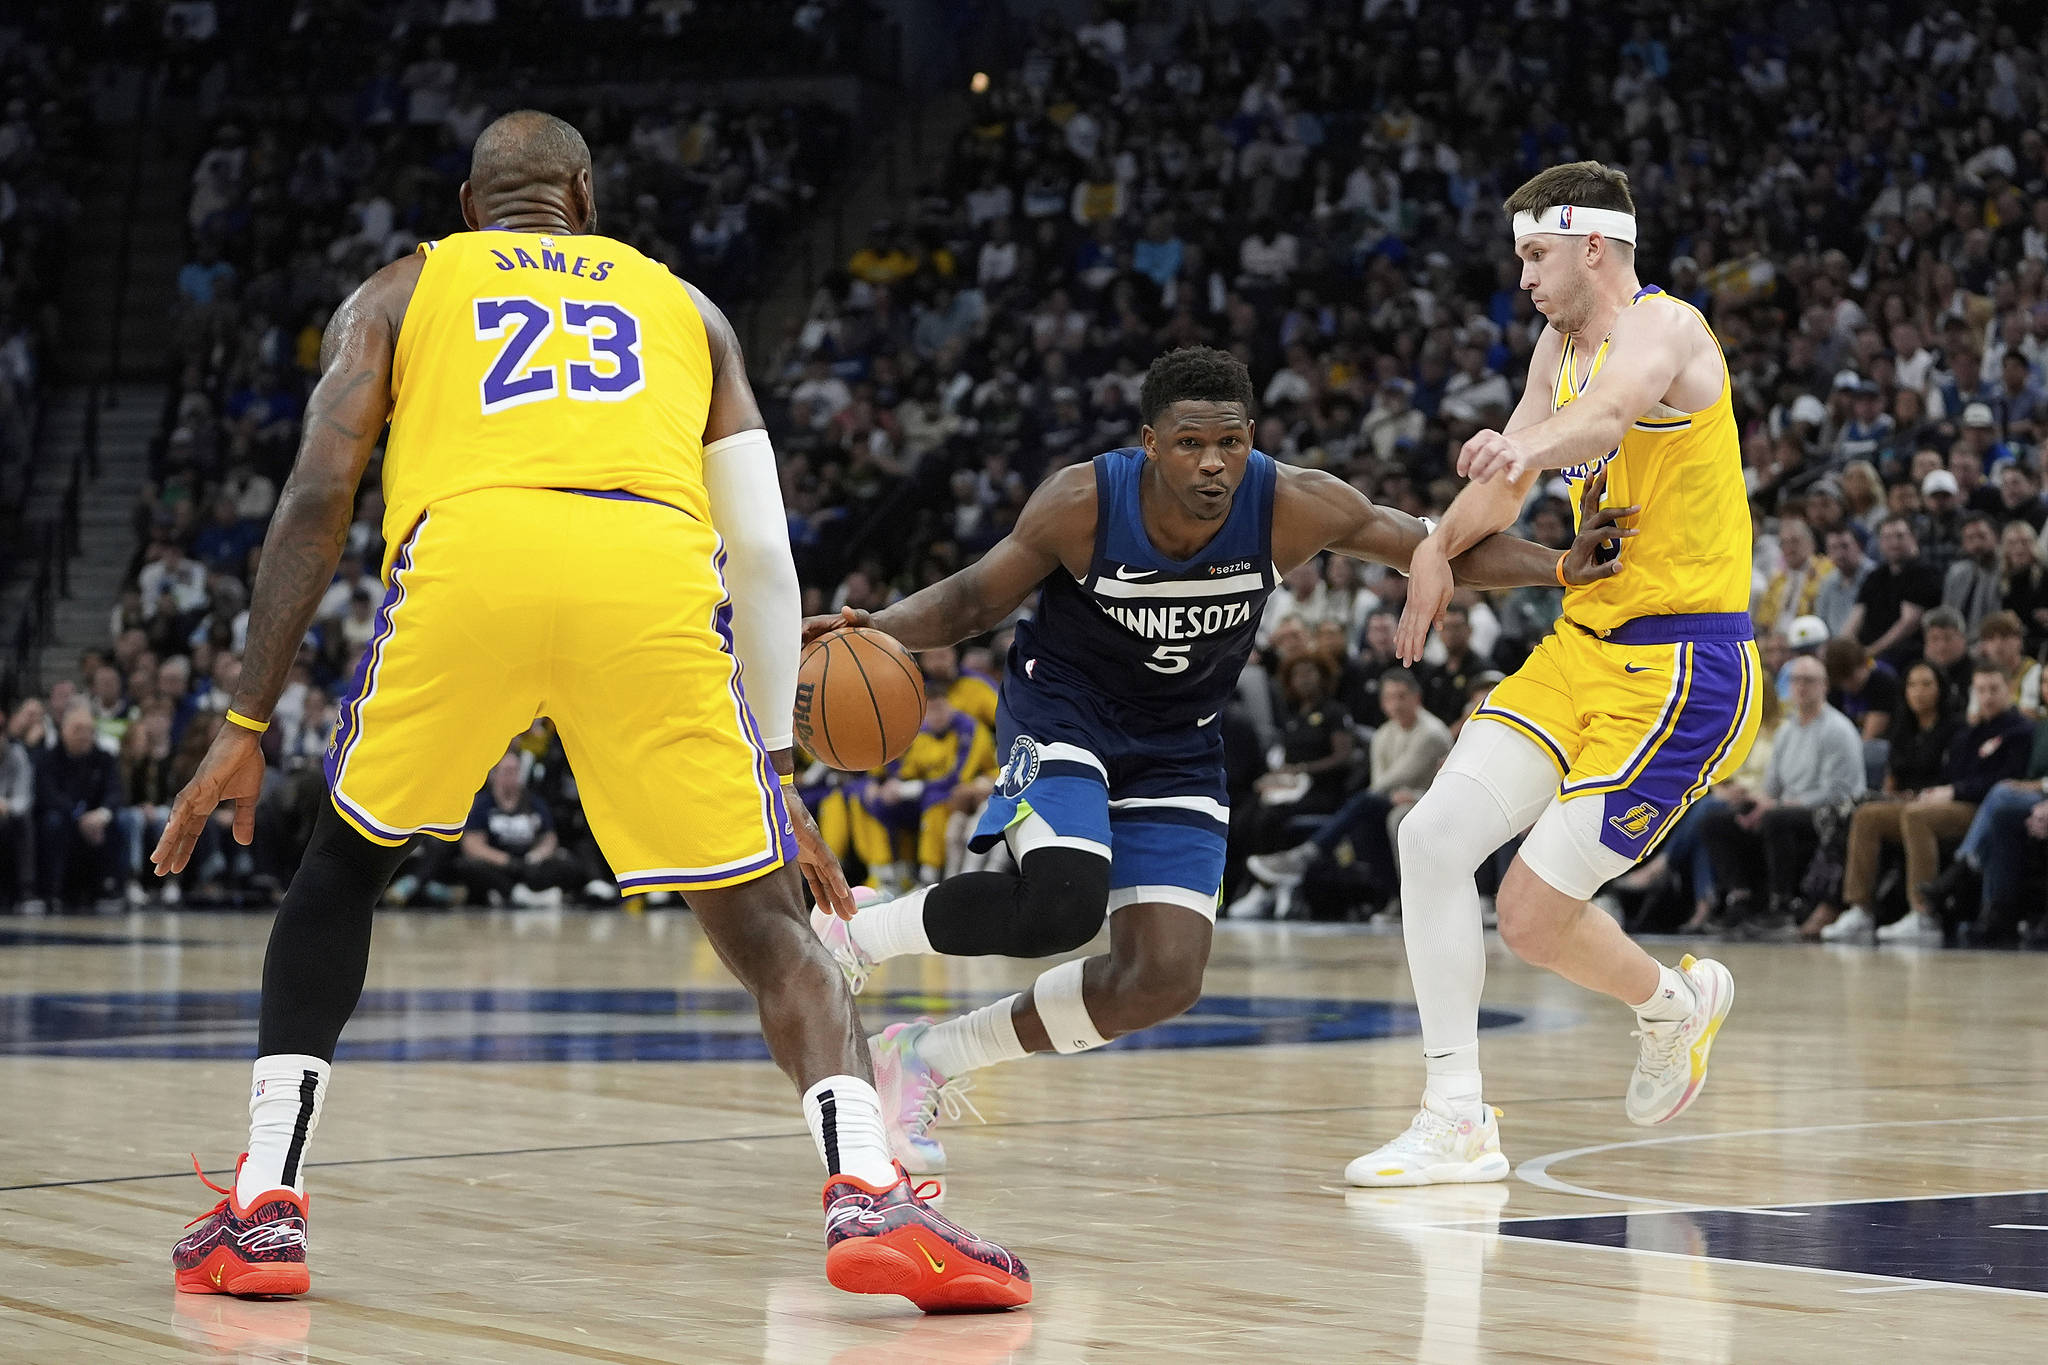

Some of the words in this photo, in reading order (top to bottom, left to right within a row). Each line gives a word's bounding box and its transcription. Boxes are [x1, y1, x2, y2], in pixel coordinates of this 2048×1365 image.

[490, 247, 616, 282] JAMES
[473, 296, 646, 415] 23
[1216, 561, 1251, 575] sezzle
[1144, 645, 1192, 674] 5
